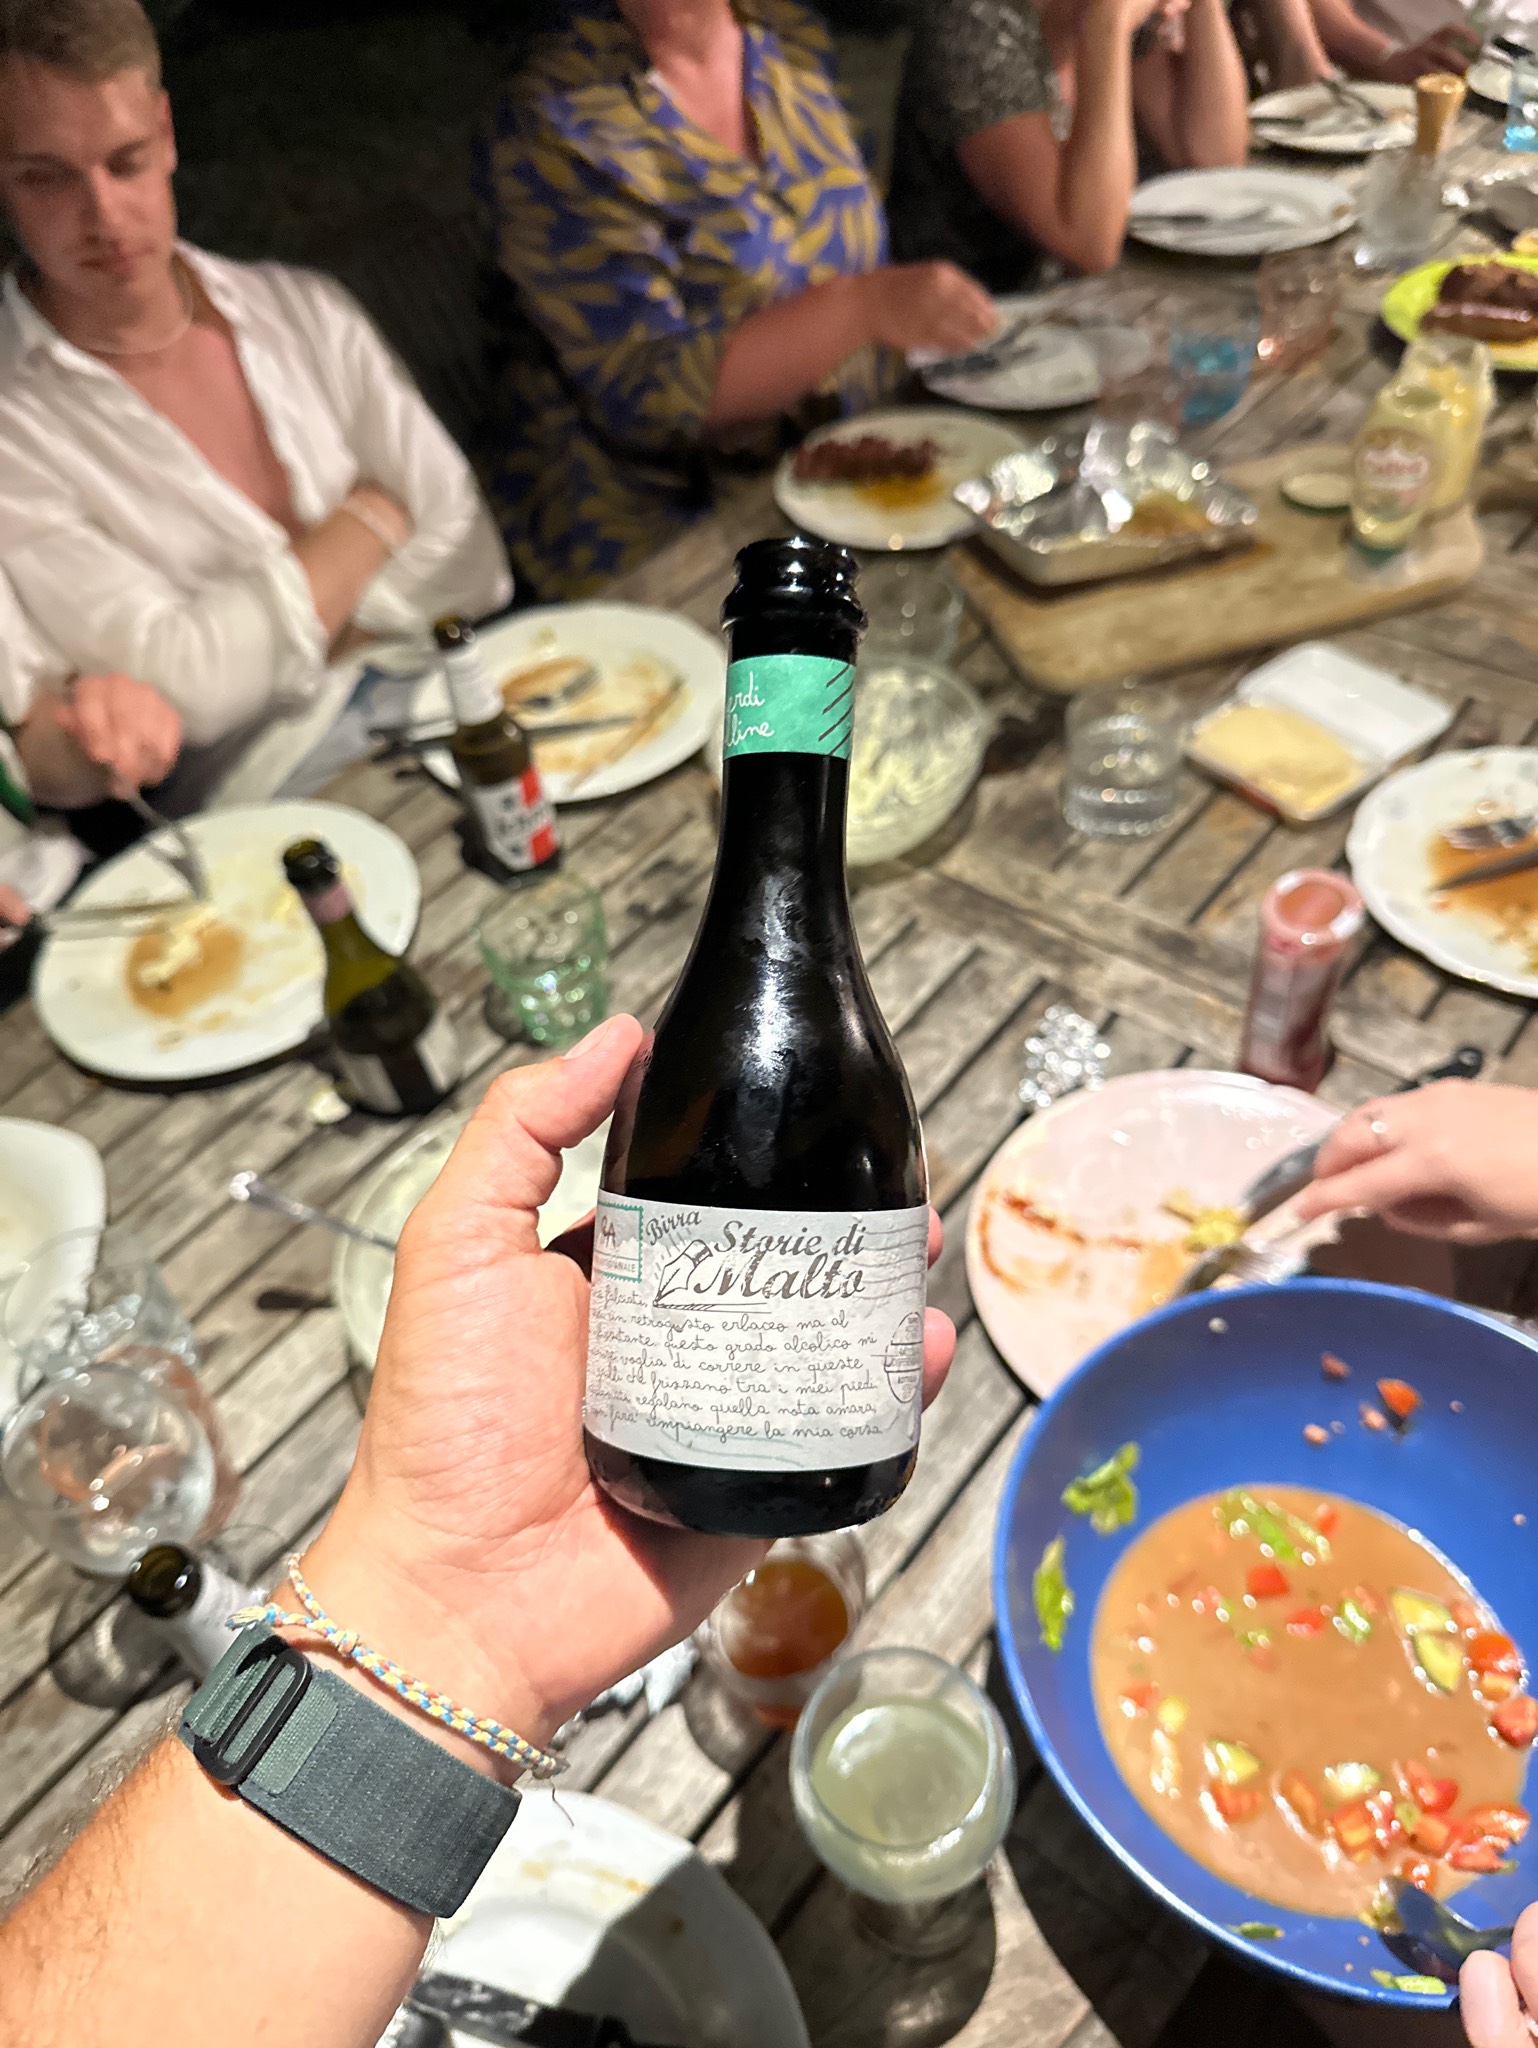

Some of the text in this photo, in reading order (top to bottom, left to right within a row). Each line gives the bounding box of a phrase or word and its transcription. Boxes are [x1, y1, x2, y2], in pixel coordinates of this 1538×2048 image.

[646, 1210, 702, 1246] Birra
[714, 1220, 867, 1256] Storie di
[693, 1250, 866, 1300] Malto
[631, 1314, 714, 1342] retrogusto
[721, 1312, 789, 1333] erbaceo
[796, 1319, 826, 1330] ma
[831, 1309, 849, 1329] al
[664, 1334, 718, 1361] questo
[725, 1332, 777, 1361] grado
[784, 1331, 852, 1353] alcolico
[857, 1332, 878, 1347] mi
[620, 1348, 667, 1371] voglia
[673, 1352, 691, 1369] di
[698, 1361, 766, 1374] correre
[774, 1362, 800, 1373] in
[807, 1356, 864, 1385] queste
[626, 1366, 647, 1385] che
[736, 1377, 771, 1394] tra
[778, 1382, 788, 1394] i
[796, 1382, 834, 1394] miei
[635, 1393, 703, 1420] regalano
[710, 1396, 770, 1425] quella
[778, 1399, 820, 1416] nota
[646, 1417, 759, 1444] rimpiangere
[764, 1420, 785, 1440] la
[793, 1428, 834, 1438] mia
